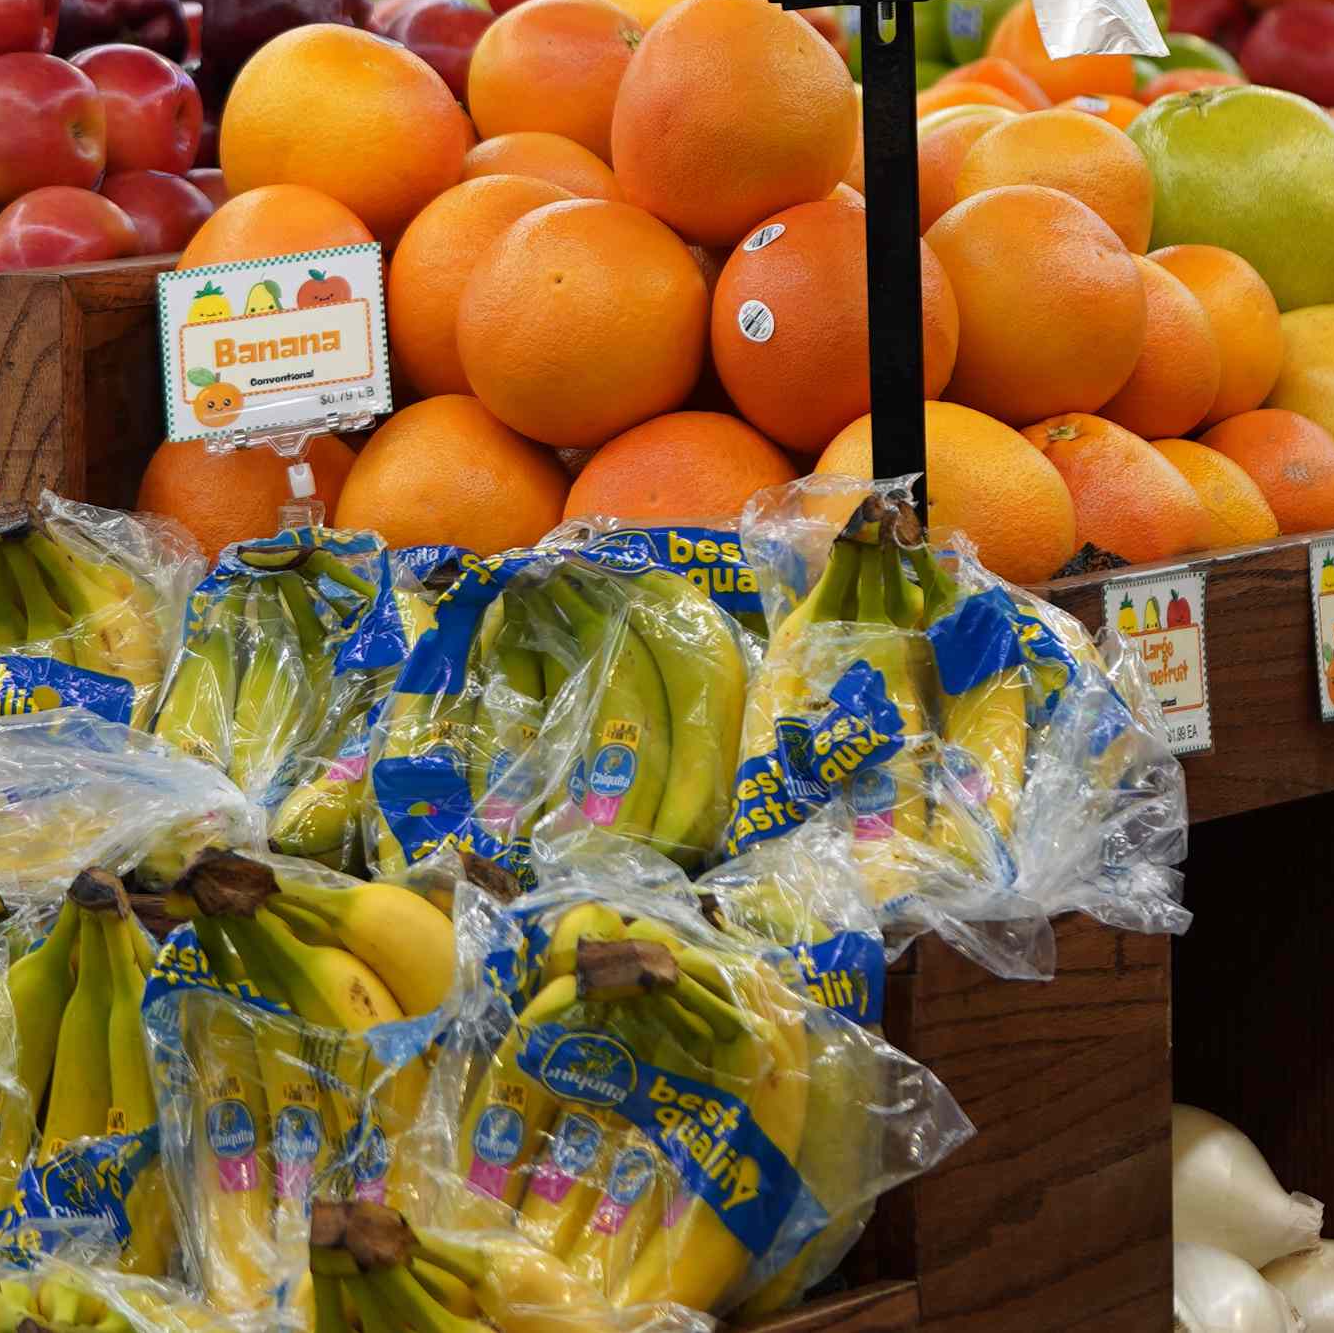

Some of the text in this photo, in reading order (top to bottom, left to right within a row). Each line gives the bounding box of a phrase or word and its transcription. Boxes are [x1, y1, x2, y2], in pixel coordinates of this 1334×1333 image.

[214, 329, 341, 369] Banana
[250, 369, 315, 387] Conventional
[669, 531, 744, 565] bes
[1142, 635, 1174, 664] Large
[1149, 659, 1190, 686] pefruit
[590, 771, 631, 789] Chiquita
[734, 760, 784, 802] est
[156, 942, 209, 974] est
[806, 968, 869, 1017] ality
[650, 1075, 740, 1138] best
[654, 1105, 762, 1212] quality
